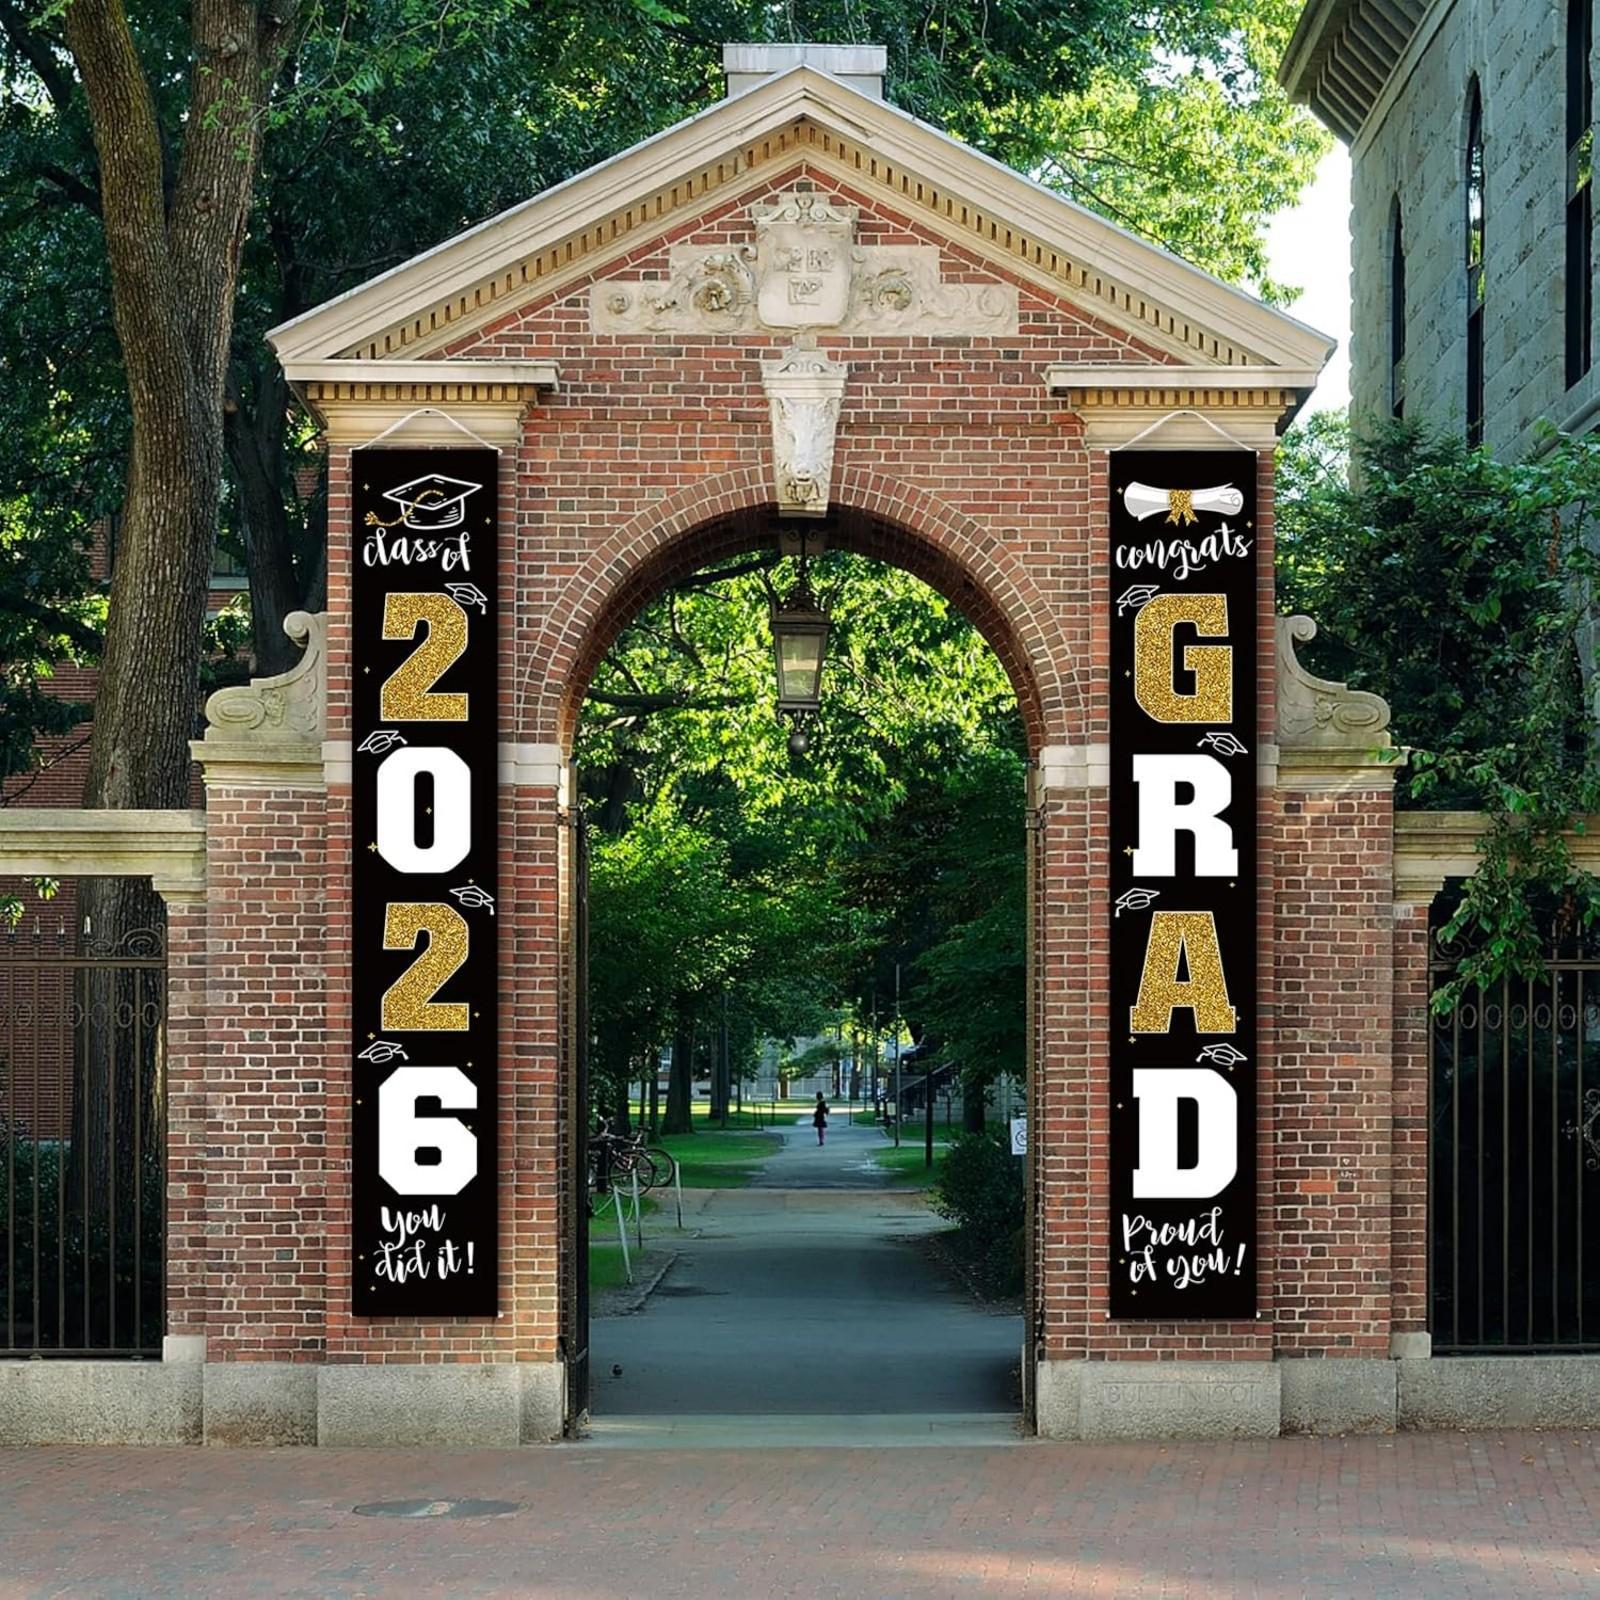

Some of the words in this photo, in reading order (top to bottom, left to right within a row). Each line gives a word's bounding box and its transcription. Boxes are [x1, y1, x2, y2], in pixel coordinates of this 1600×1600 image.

[362, 526, 443, 567] class
[441, 531, 472, 573] of
[1115, 521, 1254, 581] congrats
[376, 592, 479, 1196] 2026
[1130, 593, 1240, 1199] GRAD
[380, 1203, 446, 1250] you
[373, 1239, 431, 1284] did
[437, 1239, 475, 1280] it!
[1129, 1244, 1157, 1284] of
[1166, 1243, 1247, 1289] you!
